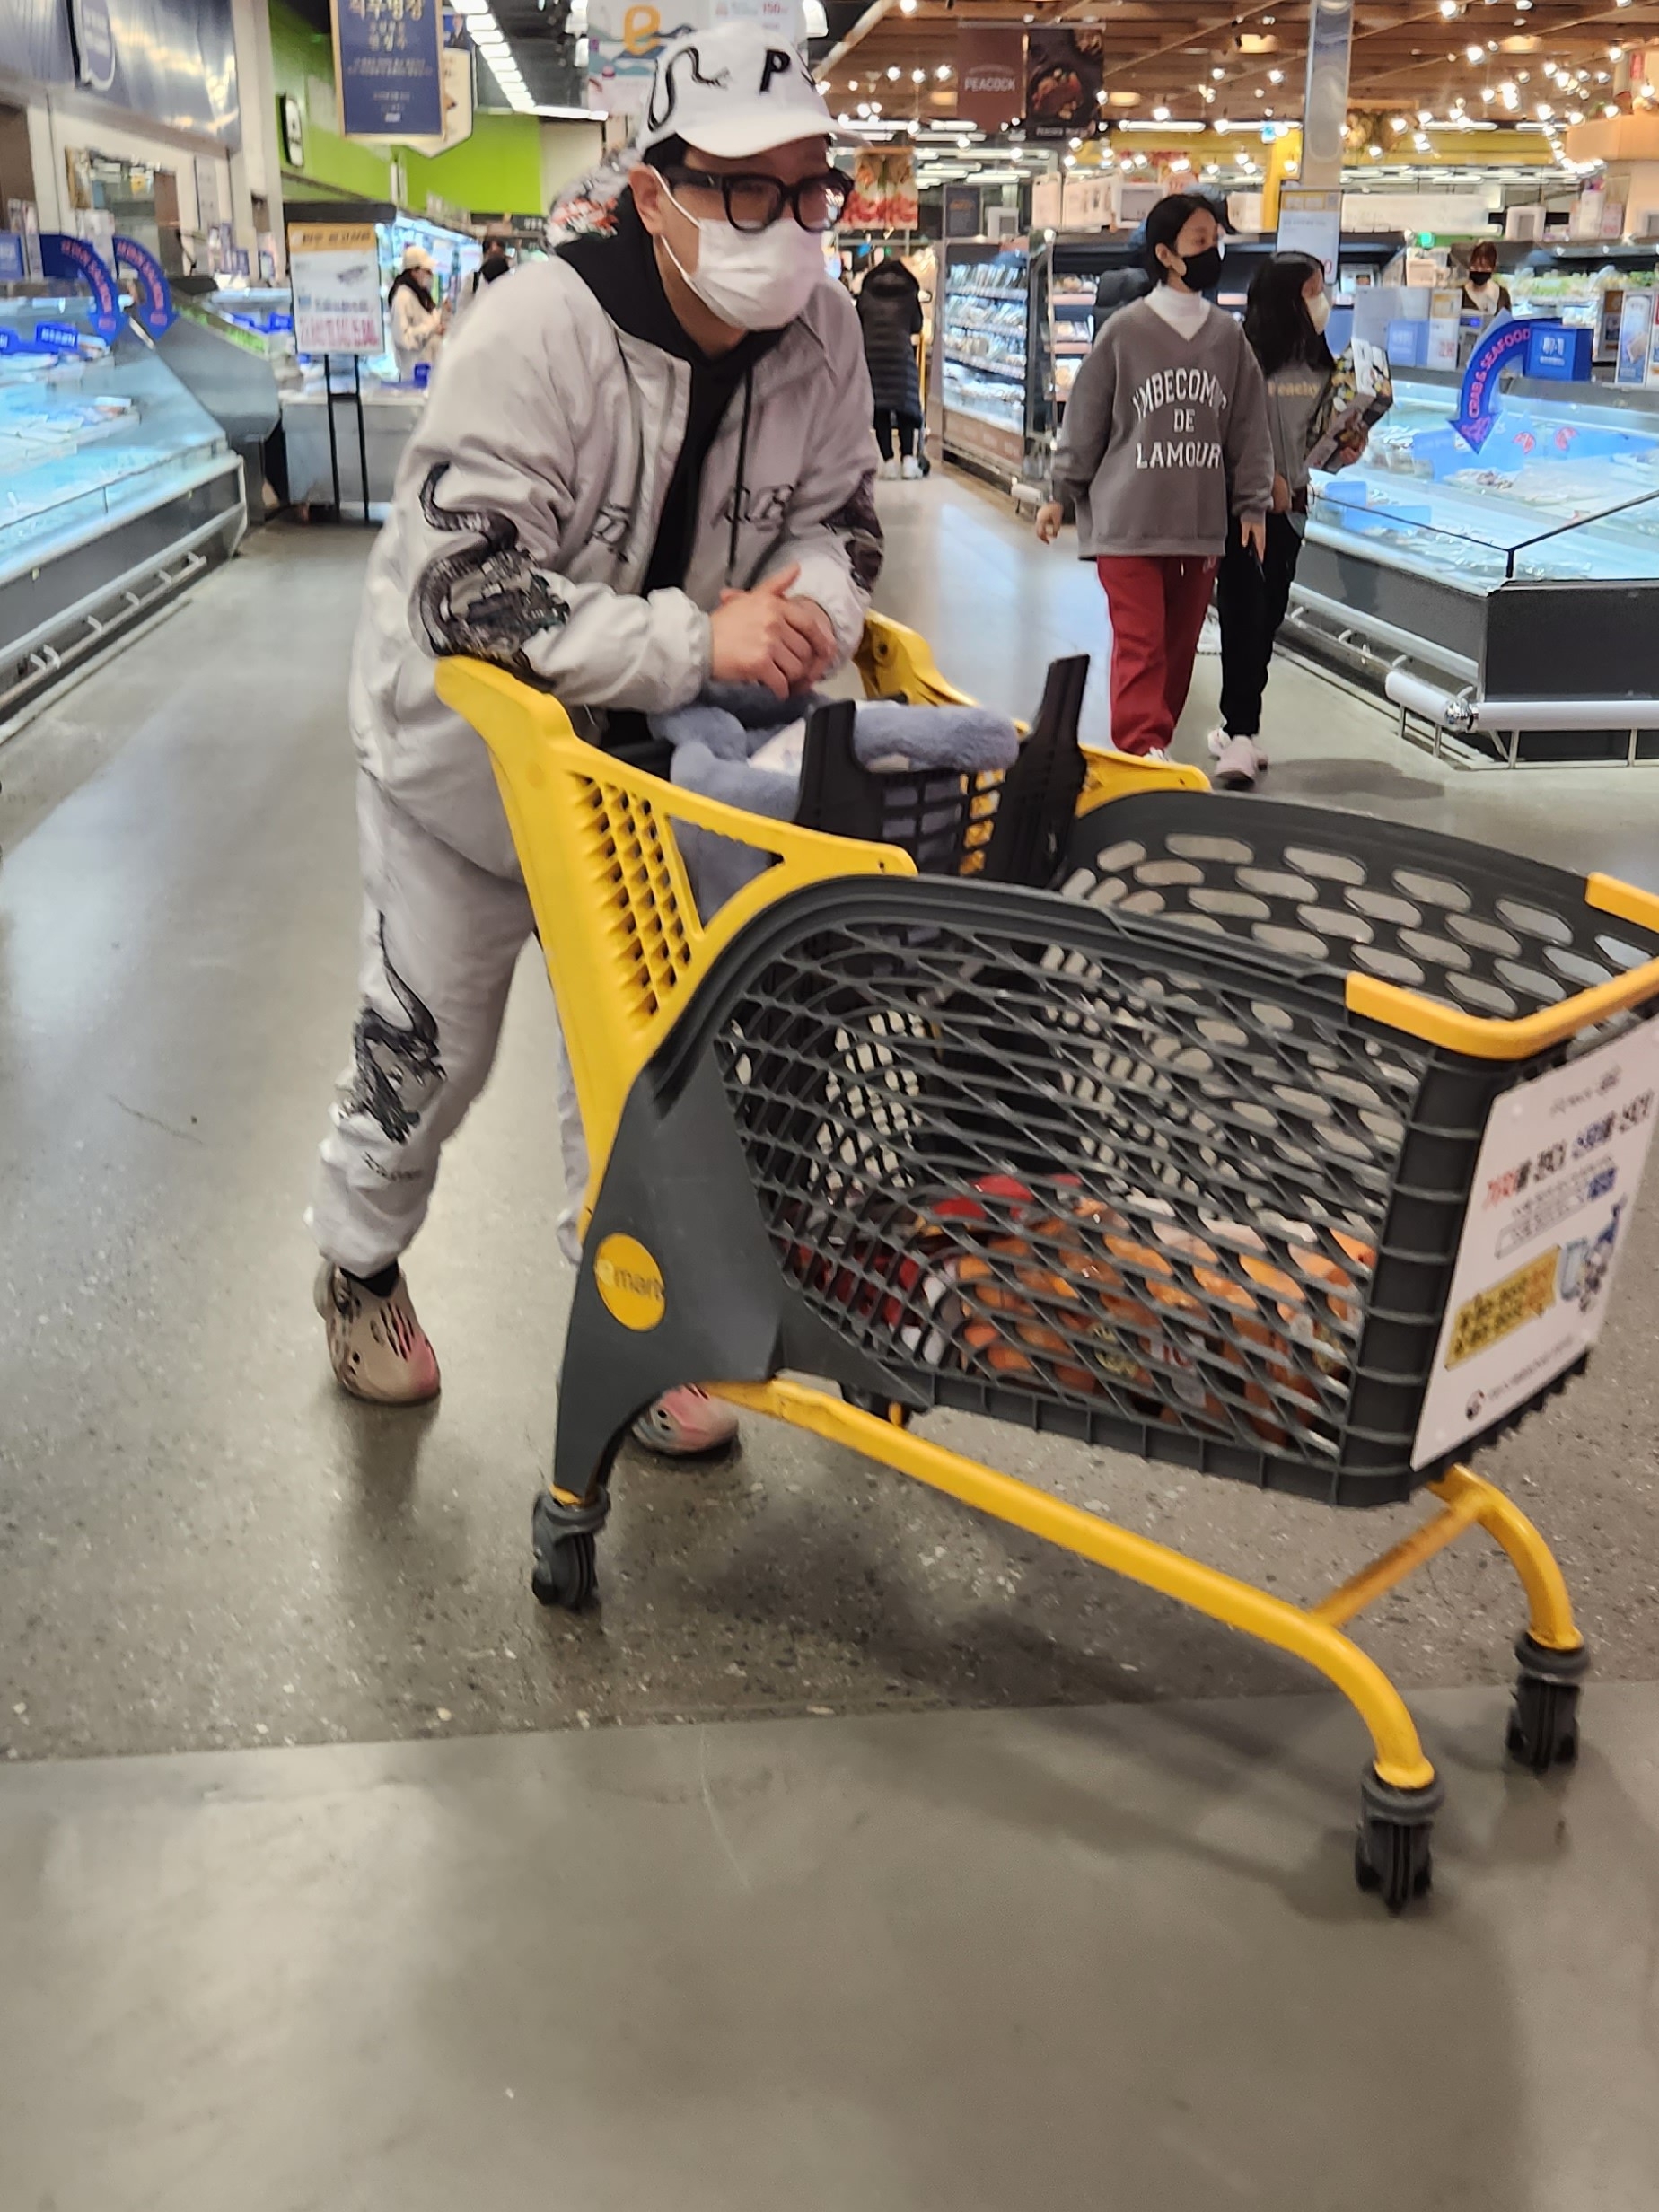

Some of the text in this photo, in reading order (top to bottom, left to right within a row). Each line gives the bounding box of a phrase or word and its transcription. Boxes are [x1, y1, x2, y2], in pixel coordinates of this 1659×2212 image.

[964, 77, 1016, 91] PEACOCK
[1480, 328, 1531, 369] SEAFOOD
[1173, 408, 1196, 433] DE
[1136, 441, 1221, 470] LAMOUR
